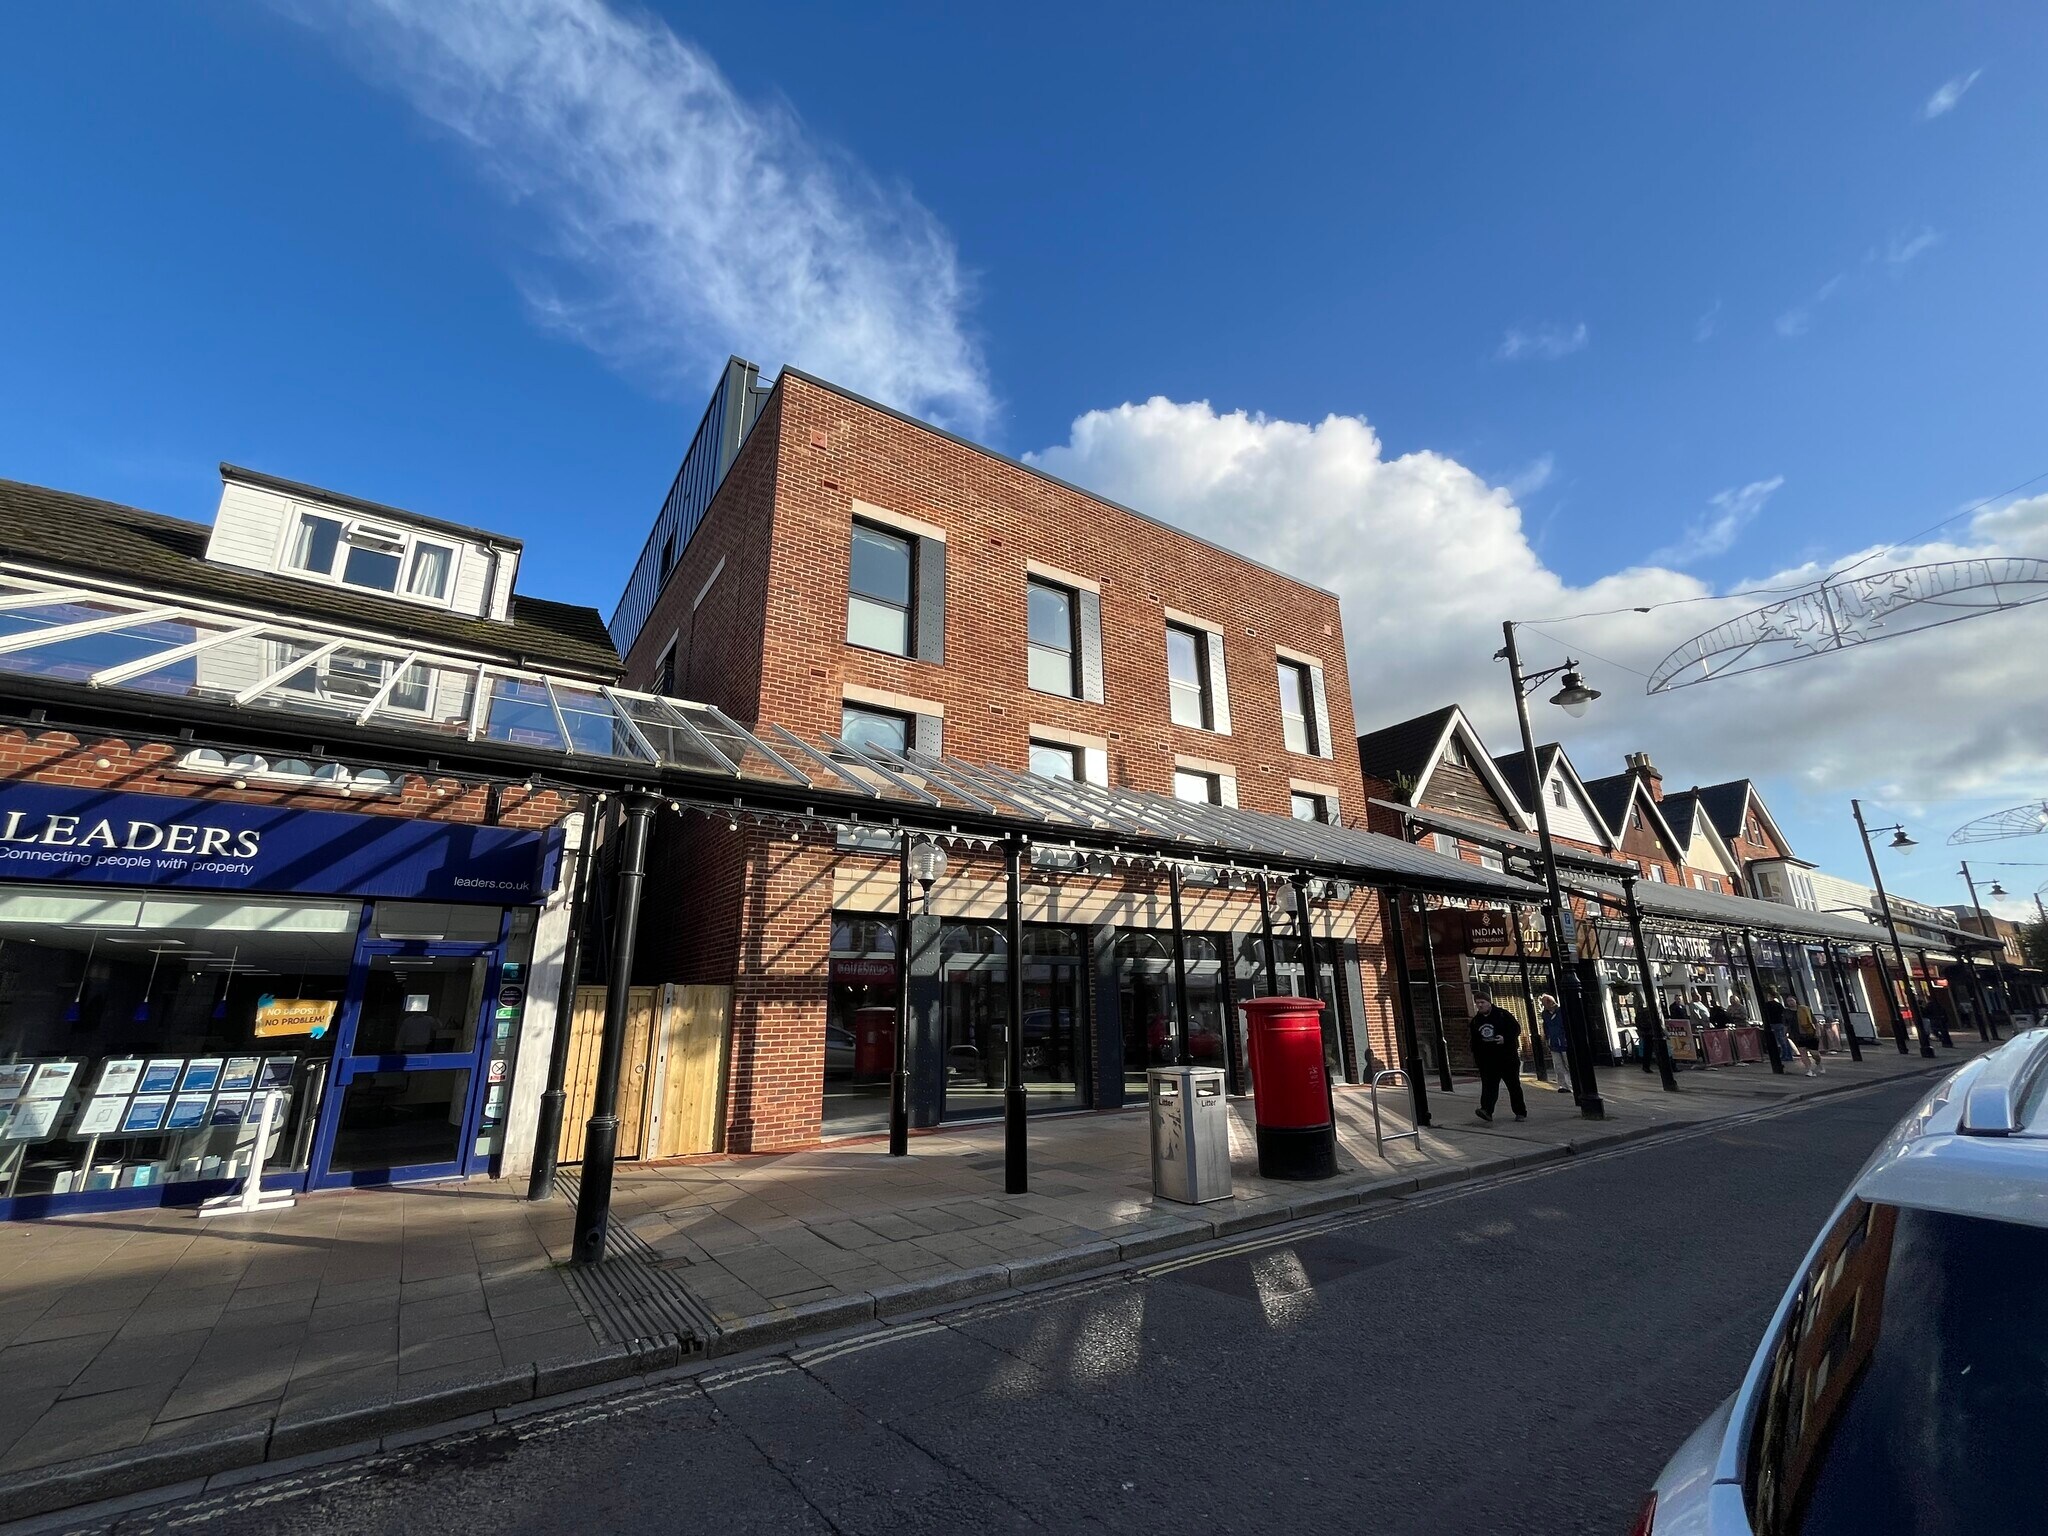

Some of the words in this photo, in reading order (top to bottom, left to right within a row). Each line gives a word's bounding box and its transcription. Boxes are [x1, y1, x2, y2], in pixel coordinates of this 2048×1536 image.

[0, 811, 261, 859] LEADERS
[0, 846, 92, 866] Connecting
[96, 855, 152, 869] people
[156, 857, 188, 870] with
[191, 861, 254, 876] property
[453, 876, 530, 891] leaders.co.uk
[1471, 927, 1504, 937] INDIAN
[1656, 934, 1677, 955] THE
[1675, 935, 1712, 957] SPITFIRE
[267, 1008, 281, 1016] NO
[281, 1016, 325, 1025] PROBLEM!
[1159, 1098, 1173, 1106] Litter
